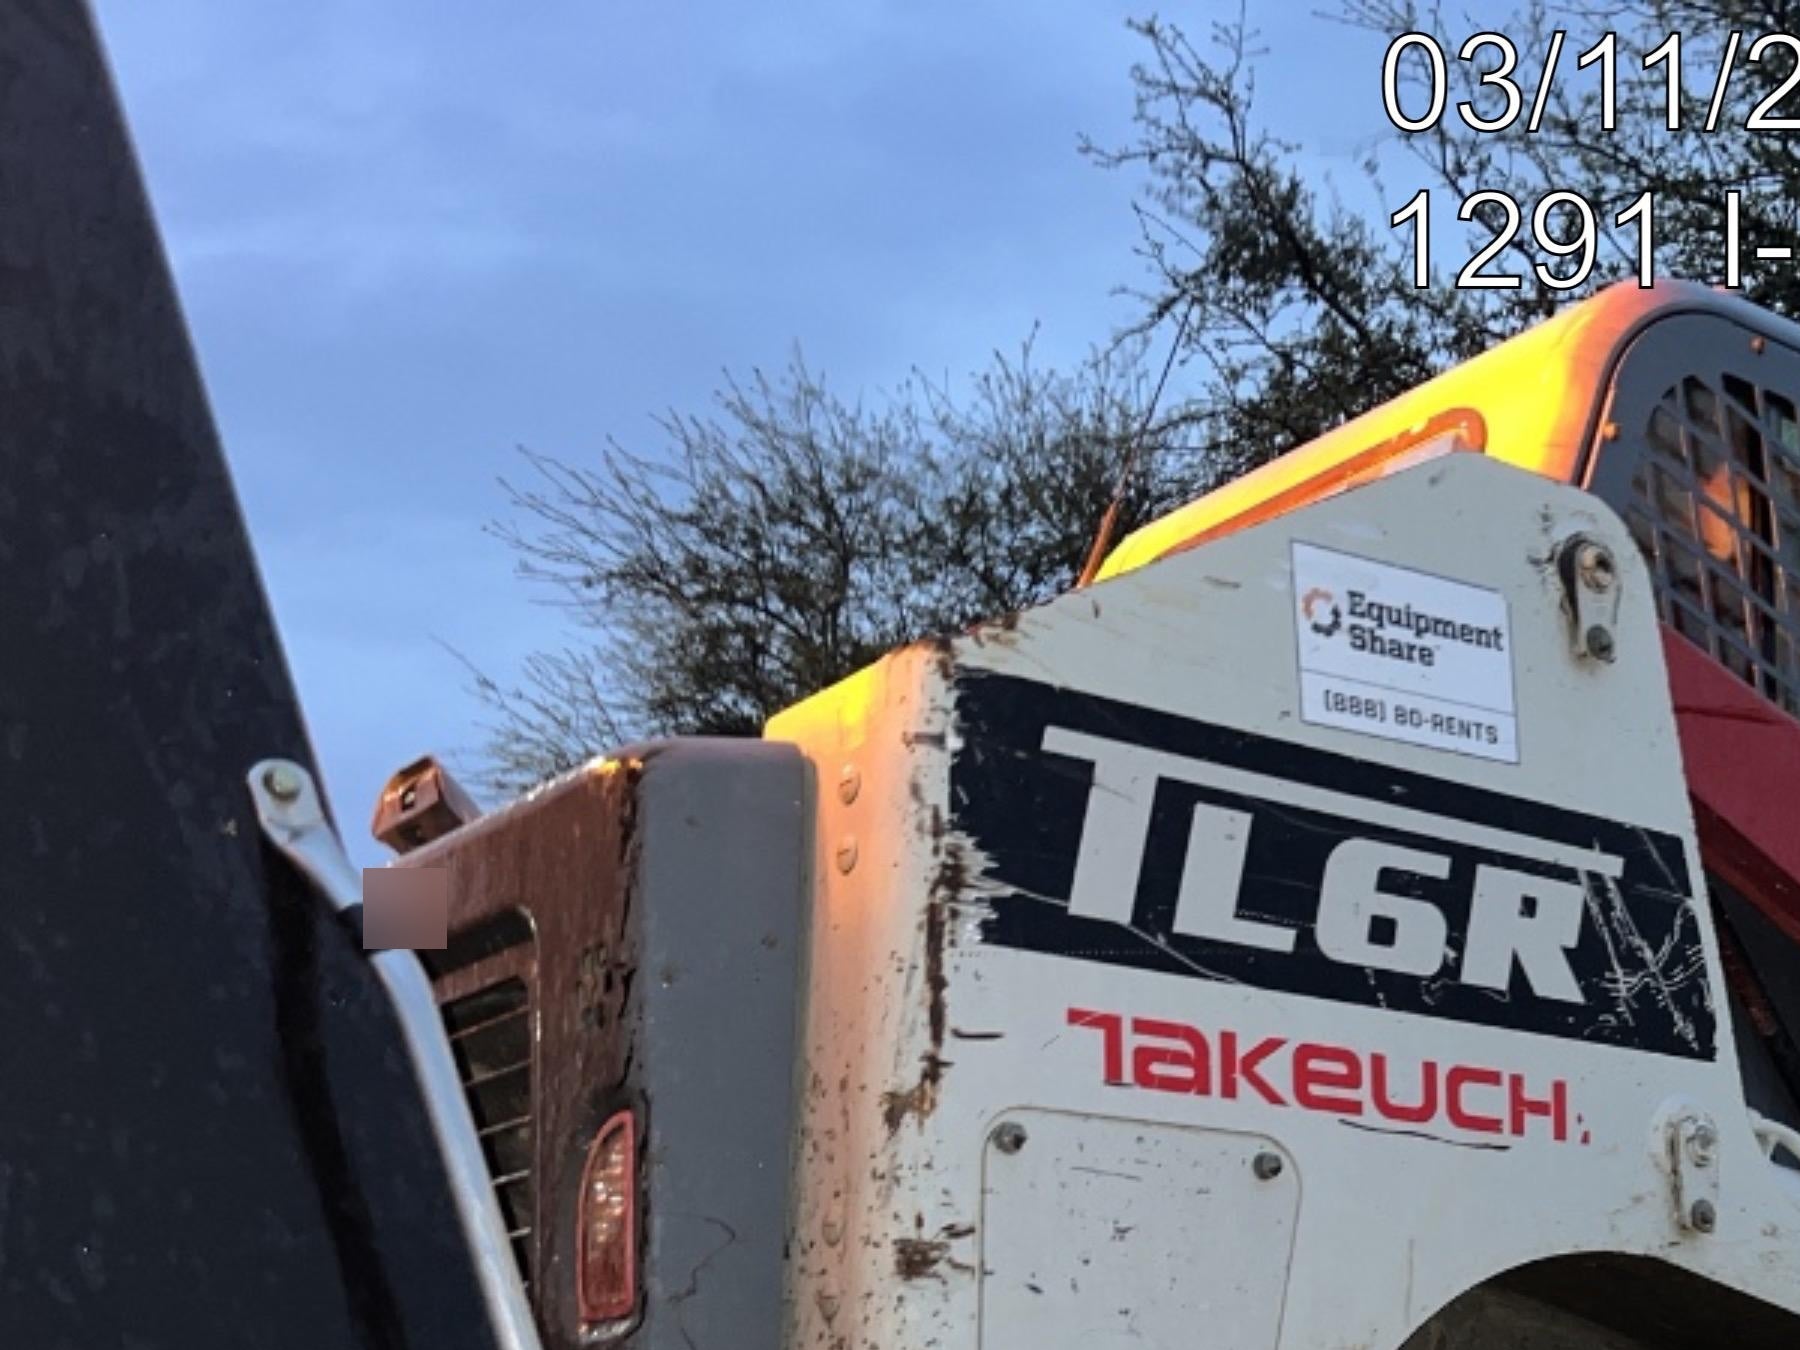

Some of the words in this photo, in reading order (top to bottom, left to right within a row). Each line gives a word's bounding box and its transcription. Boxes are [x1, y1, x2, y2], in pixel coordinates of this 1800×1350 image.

[1346, 589, 1504, 652] Equipment
[1347, 623, 1436, 667] Share
[1322, 688, 1387, 723] (888)
[1393, 704, 1499, 745] 80-RENTS
[1039, 725, 1625, 1004] TL6R
